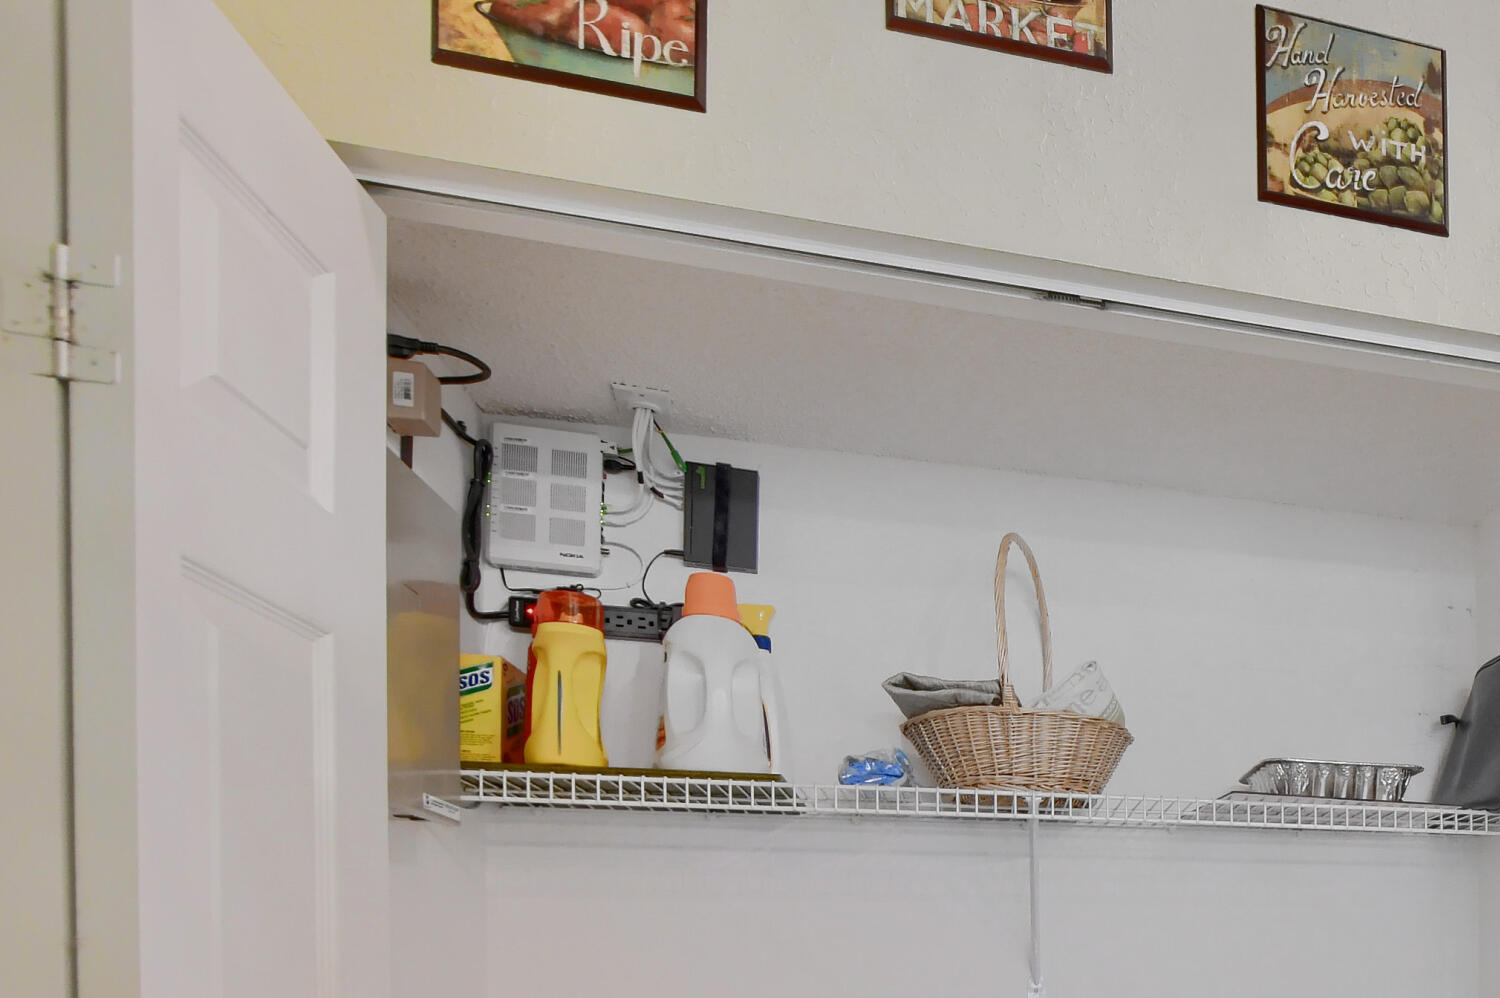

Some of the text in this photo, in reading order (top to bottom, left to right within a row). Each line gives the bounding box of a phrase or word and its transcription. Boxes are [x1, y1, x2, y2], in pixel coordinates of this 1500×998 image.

[578, 0, 689, 81] Ripe
[894, 0, 1105, 56] MARKET
[1265, 22, 1336, 69] Hand
[1303, 66, 1425, 114] Harvested
[1289, 120, 1377, 191] Care
